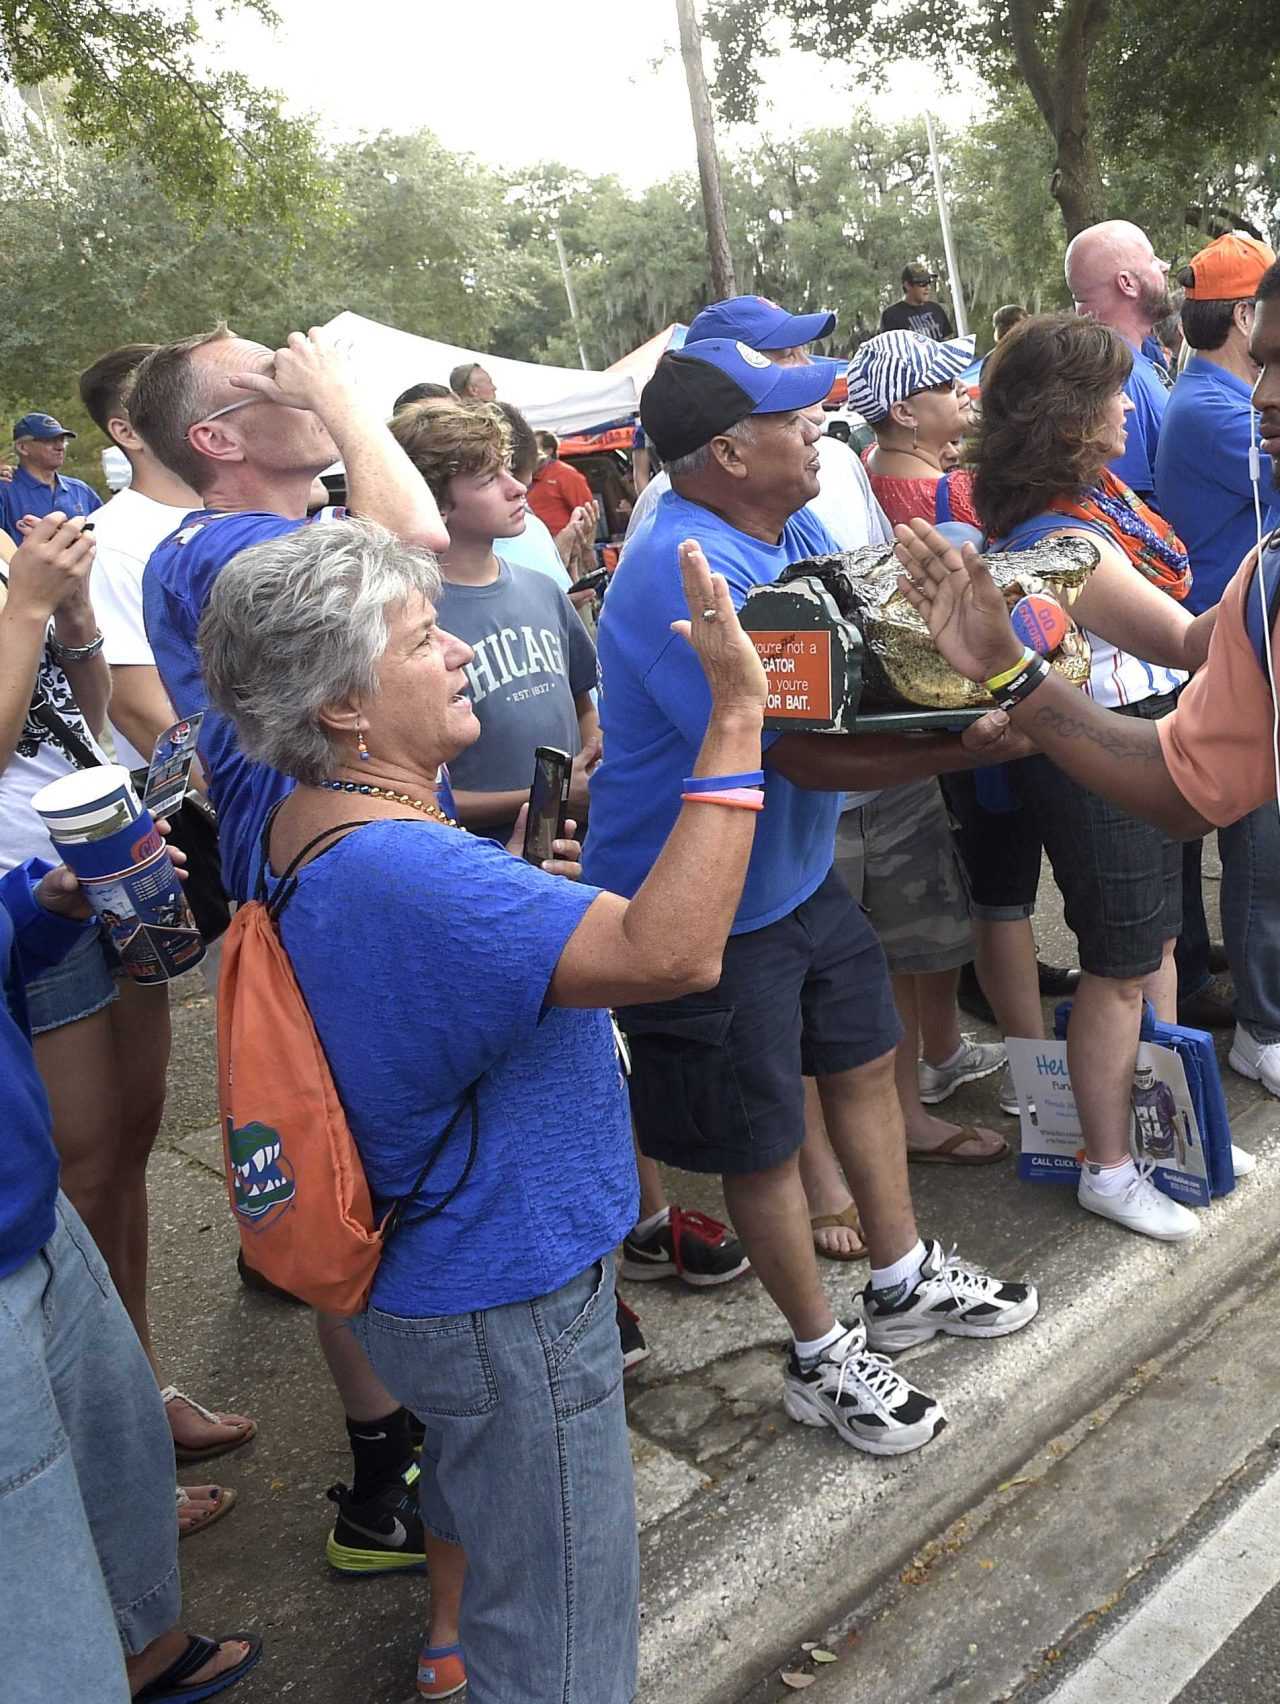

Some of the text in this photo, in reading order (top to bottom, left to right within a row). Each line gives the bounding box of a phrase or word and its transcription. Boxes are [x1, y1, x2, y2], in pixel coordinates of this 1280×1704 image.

[786, 640, 805, 655] not
[809, 642, 817, 655] a
[465, 626, 567, 703] HICAG
[785, 694, 811, 711] BAIT.
